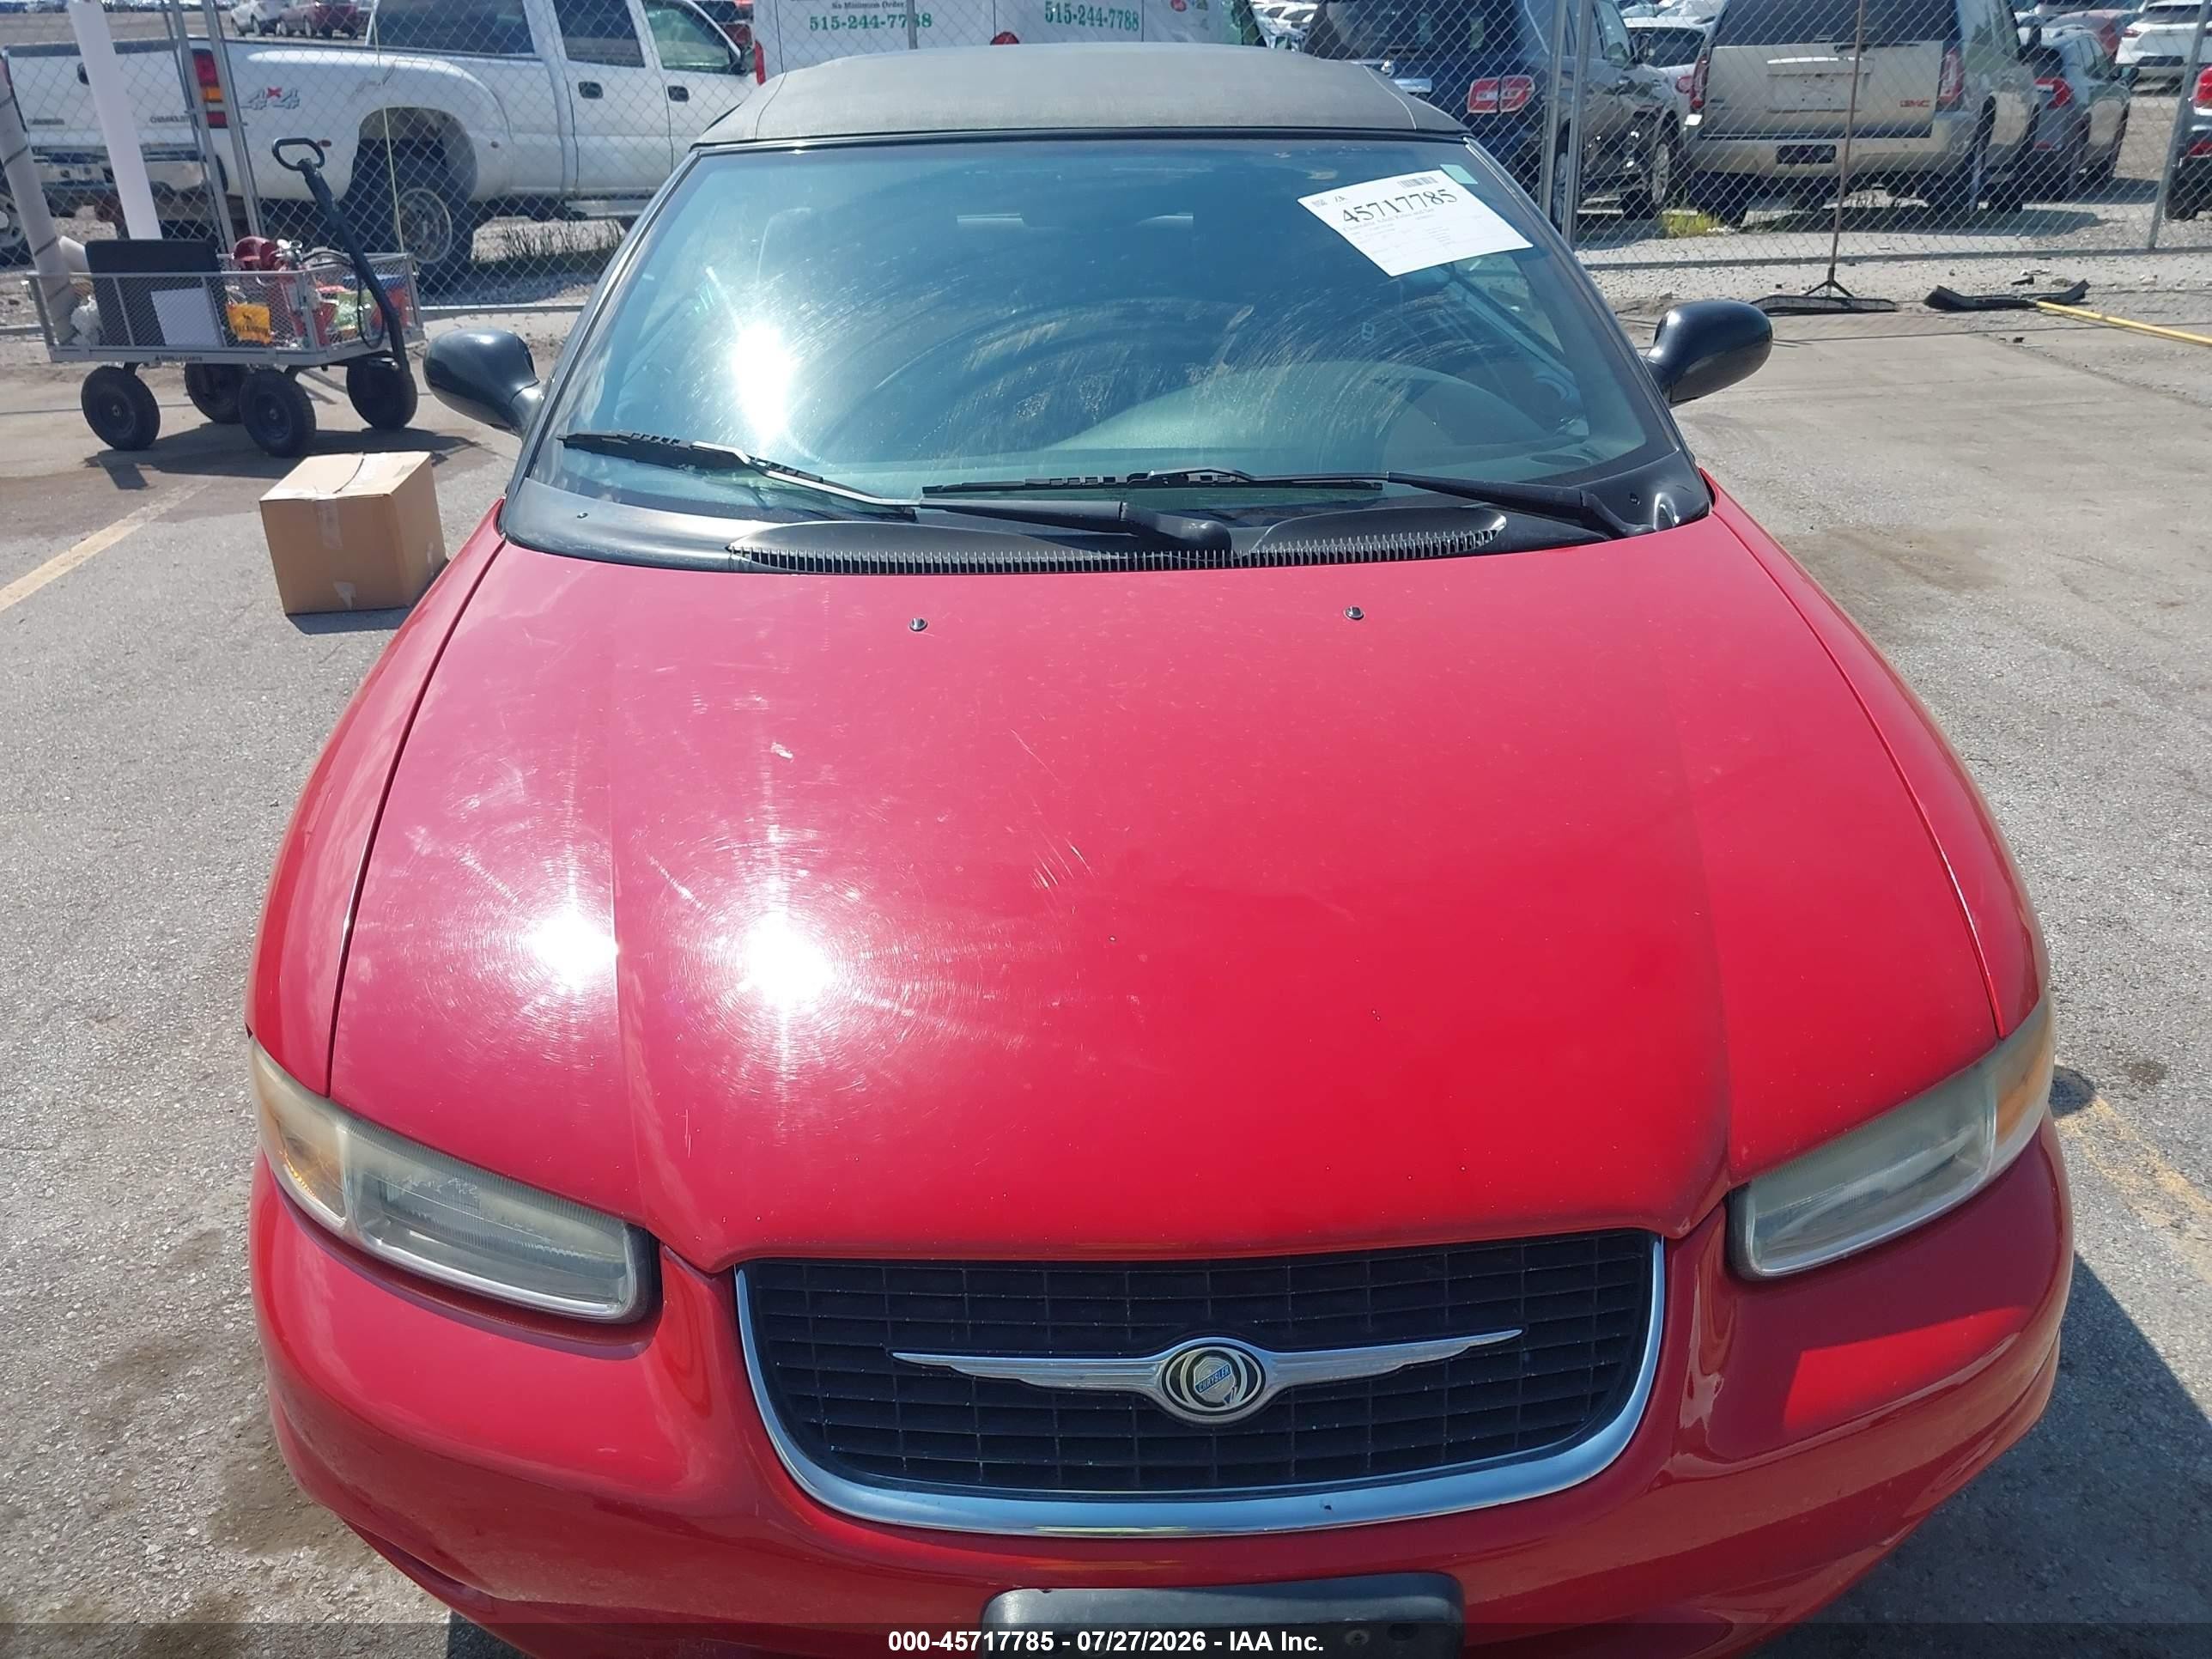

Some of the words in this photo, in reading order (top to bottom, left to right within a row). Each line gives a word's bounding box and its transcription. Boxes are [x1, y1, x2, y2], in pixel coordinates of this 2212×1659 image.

[1045, 1, 1139, 32] 515-244-7788
[1343, 189, 1457, 222] 45717785
[1198, 1364, 1231, 1393] CHRYSLER
